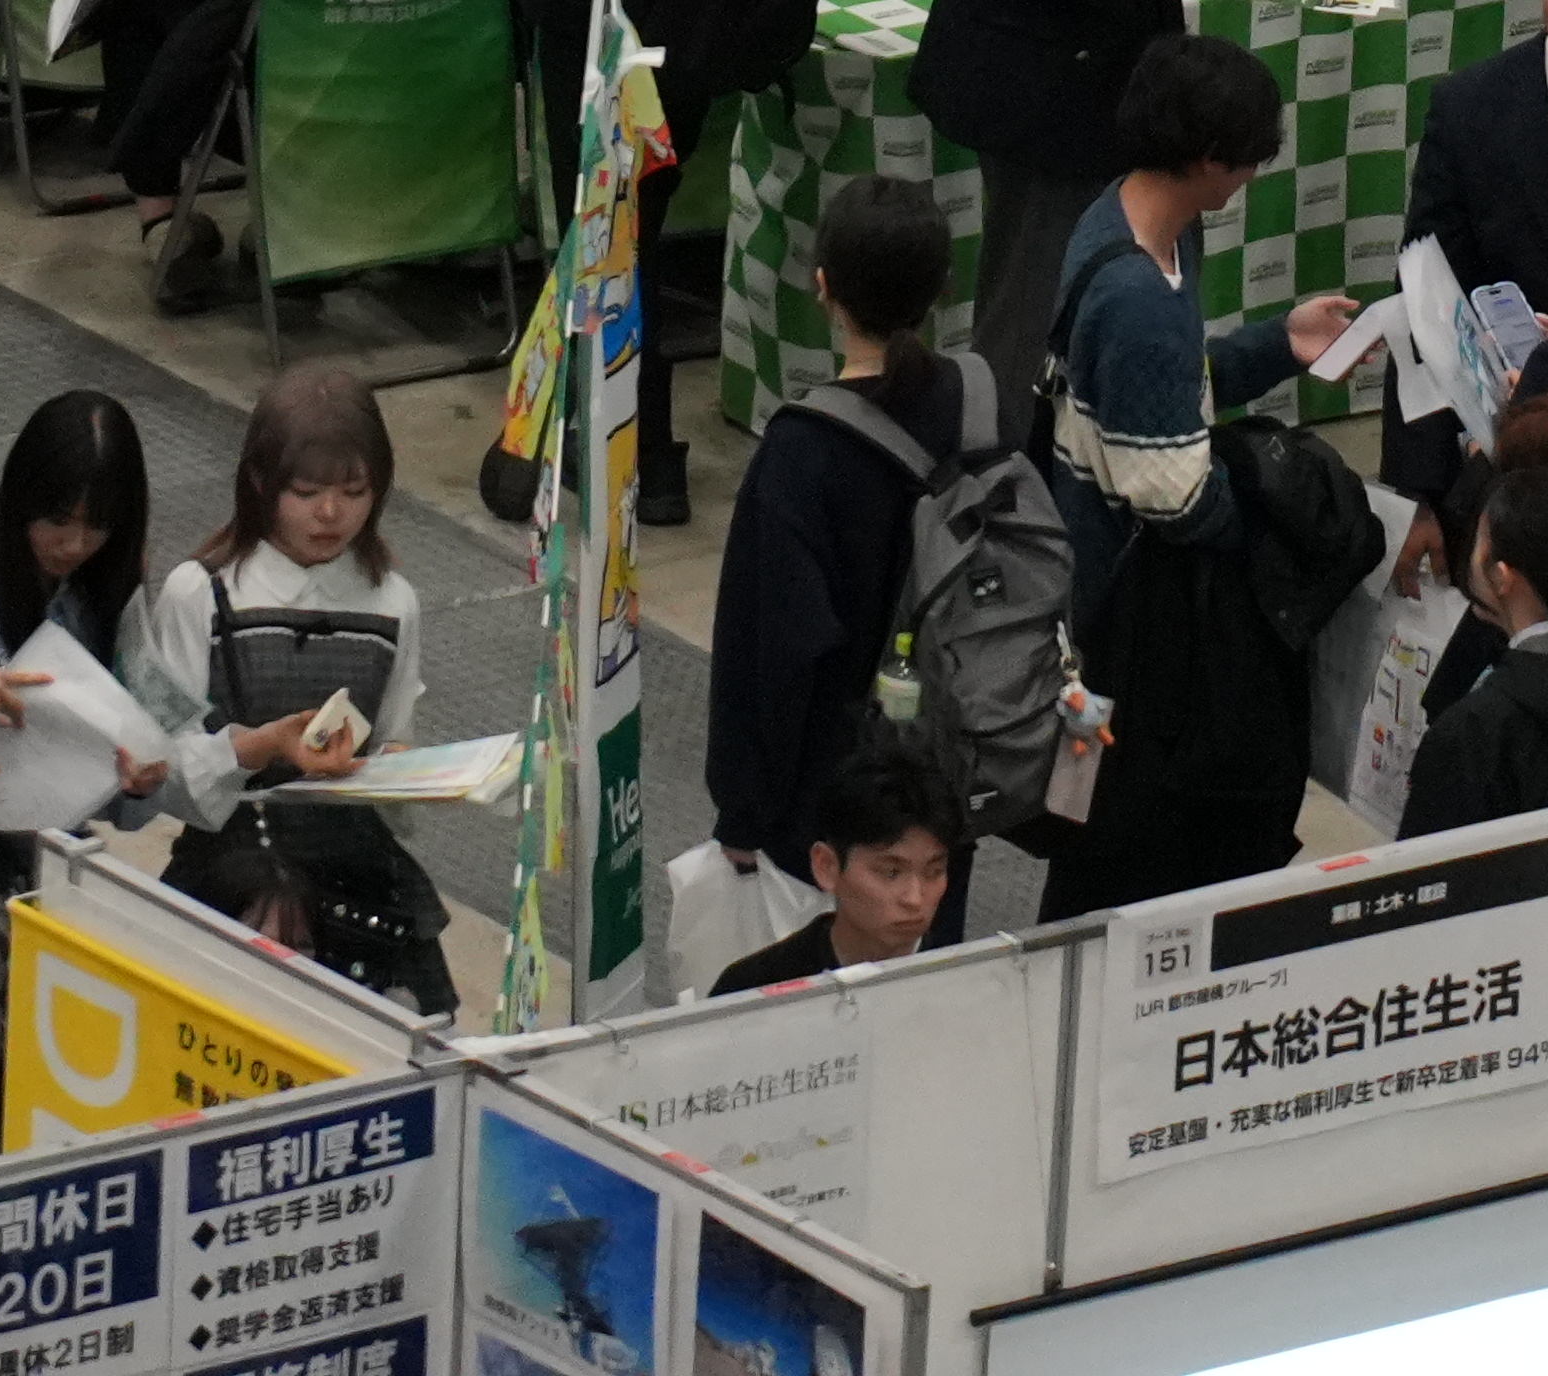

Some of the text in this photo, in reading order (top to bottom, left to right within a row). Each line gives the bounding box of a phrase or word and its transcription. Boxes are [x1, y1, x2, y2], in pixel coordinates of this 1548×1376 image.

[1143, 945, 1193, 979] 151
[1171, 960, 1523, 1092] 日本総合住生活
[656, 1062, 831, 1128] 日本総合住生活
[1127, 1049, 1503, 1159] 安定基盤・充実な福利厚生で新卒定着率
[217, 1108, 409, 1204] 福利厚生
[222, 1176, 395, 1248] 住宅手当あり
[215, 1229, 380, 1304] 資格取得支援
[215, 1273, 406, 1349] 奨学金返済支援
